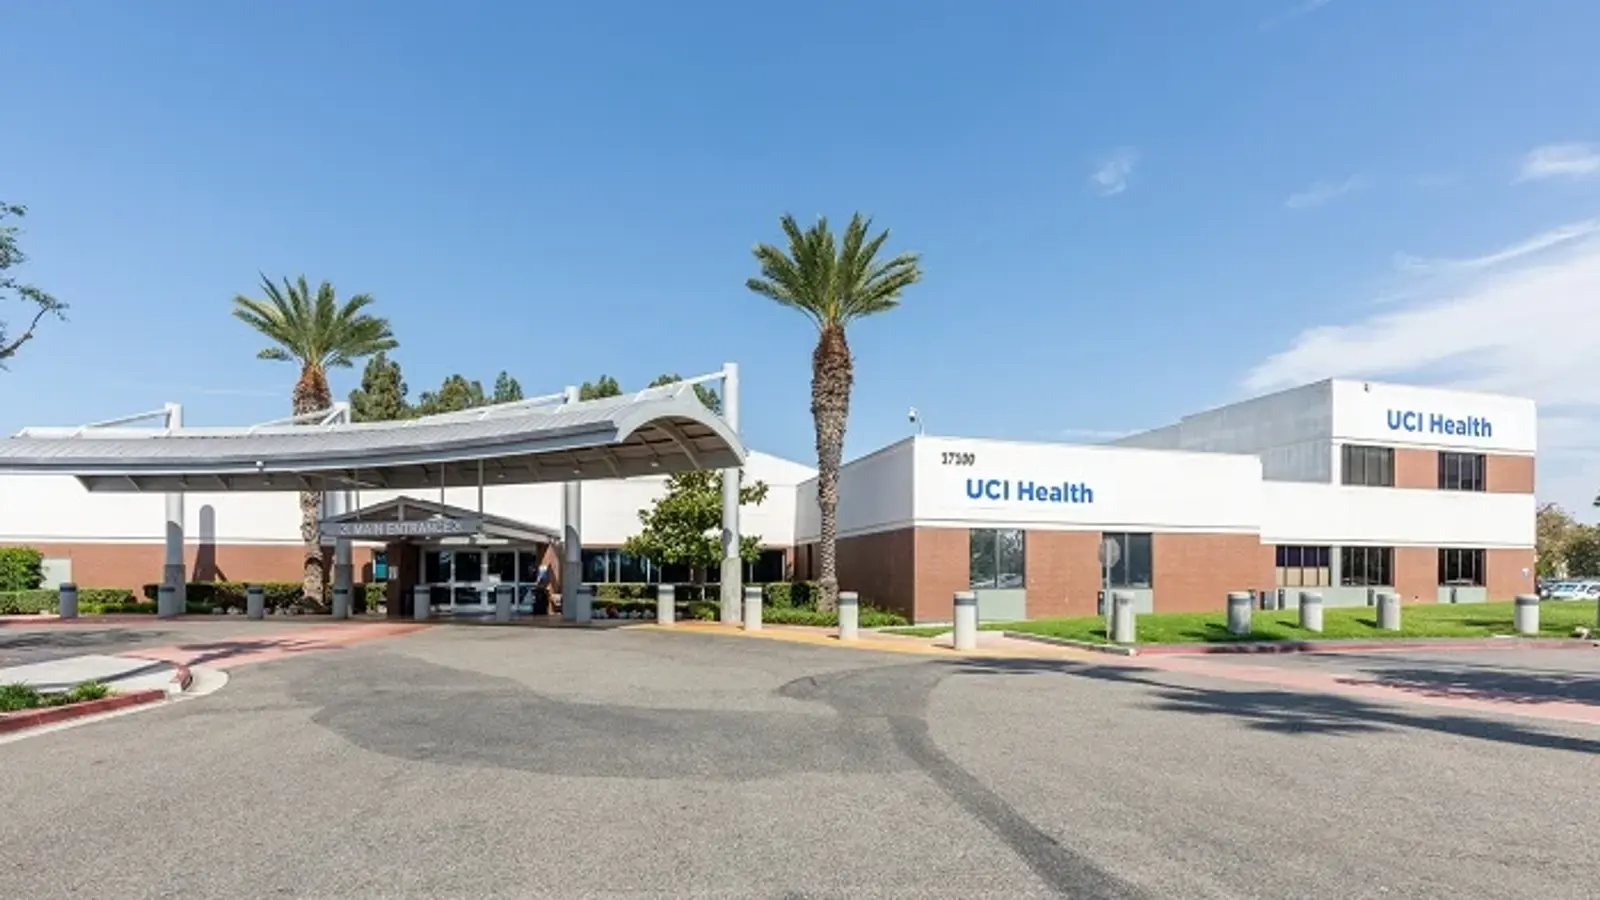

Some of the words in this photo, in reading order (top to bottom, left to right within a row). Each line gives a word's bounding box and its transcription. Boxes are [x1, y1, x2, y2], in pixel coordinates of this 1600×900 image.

[1386, 409, 1424, 433] UCI
[1429, 412, 1493, 438] Health
[966, 478, 1010, 501] UCI
[1017, 480, 1094, 503] Health
